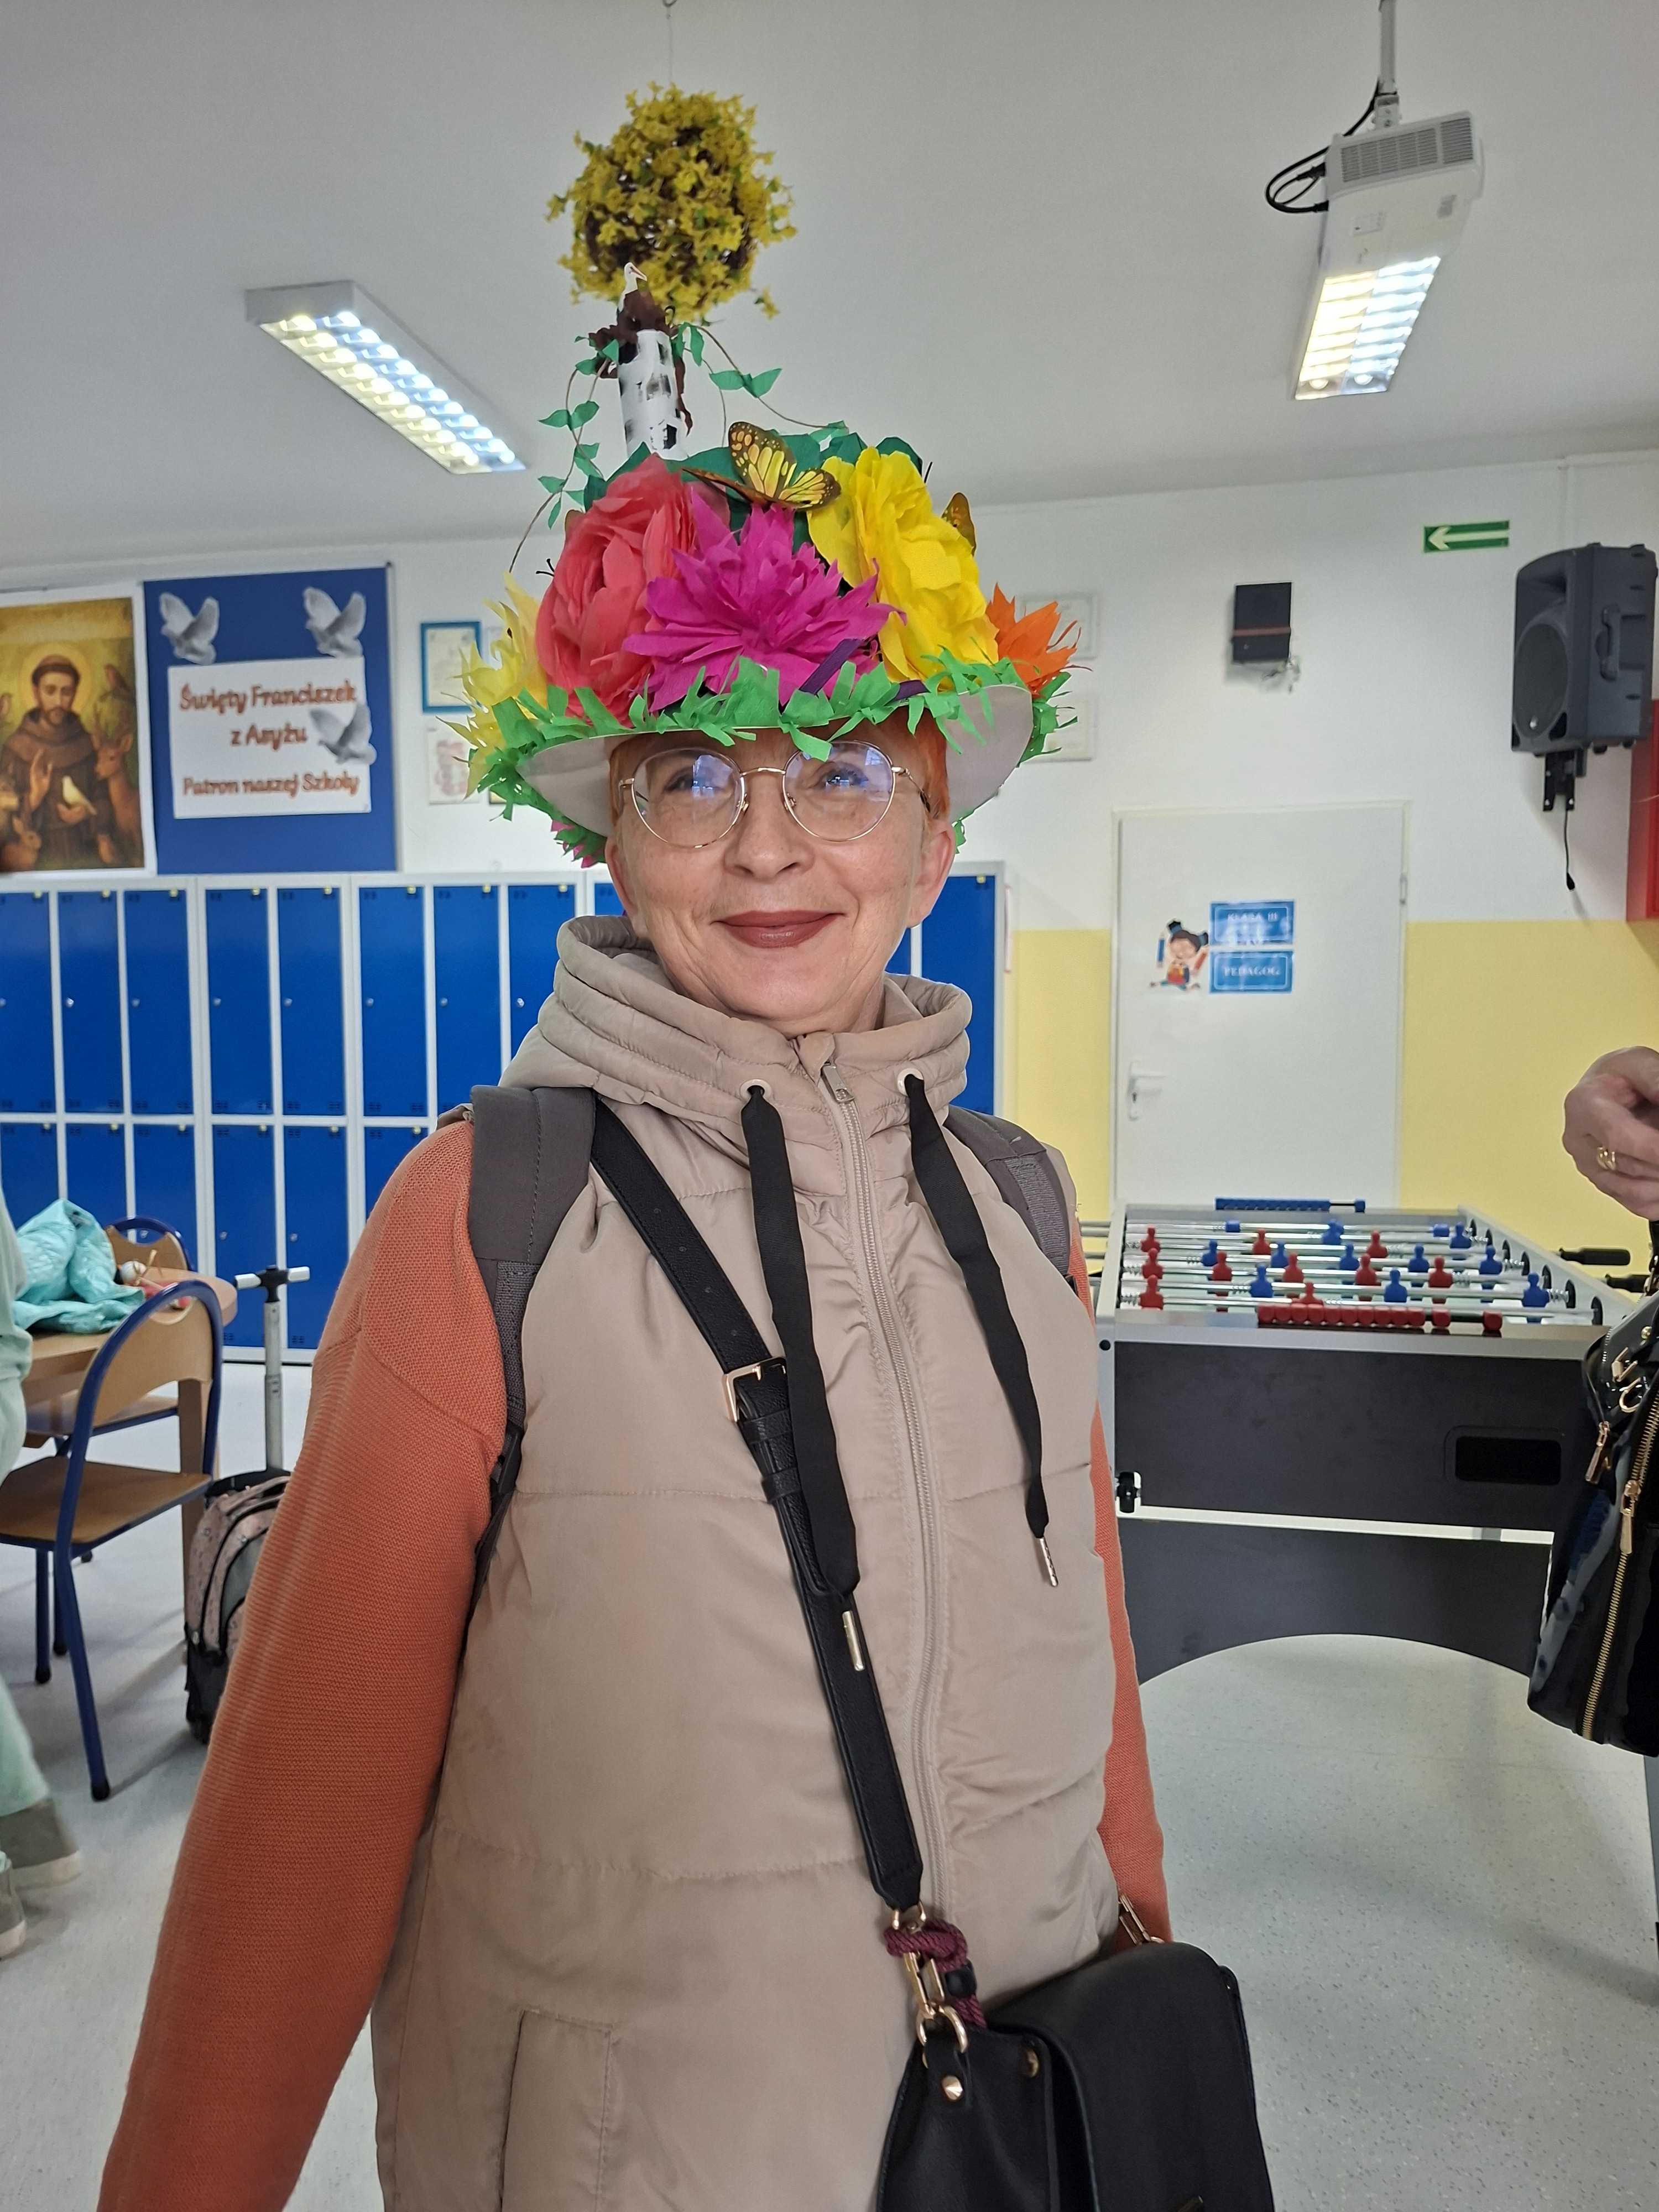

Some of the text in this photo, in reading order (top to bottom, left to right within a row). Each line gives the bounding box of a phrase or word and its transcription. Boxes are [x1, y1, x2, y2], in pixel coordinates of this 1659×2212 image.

[180, 679, 356, 714] Święty Franciszek
[231, 723, 307, 750] z Asyżu
[183, 771, 359, 798] Patron naszej Szkoły
